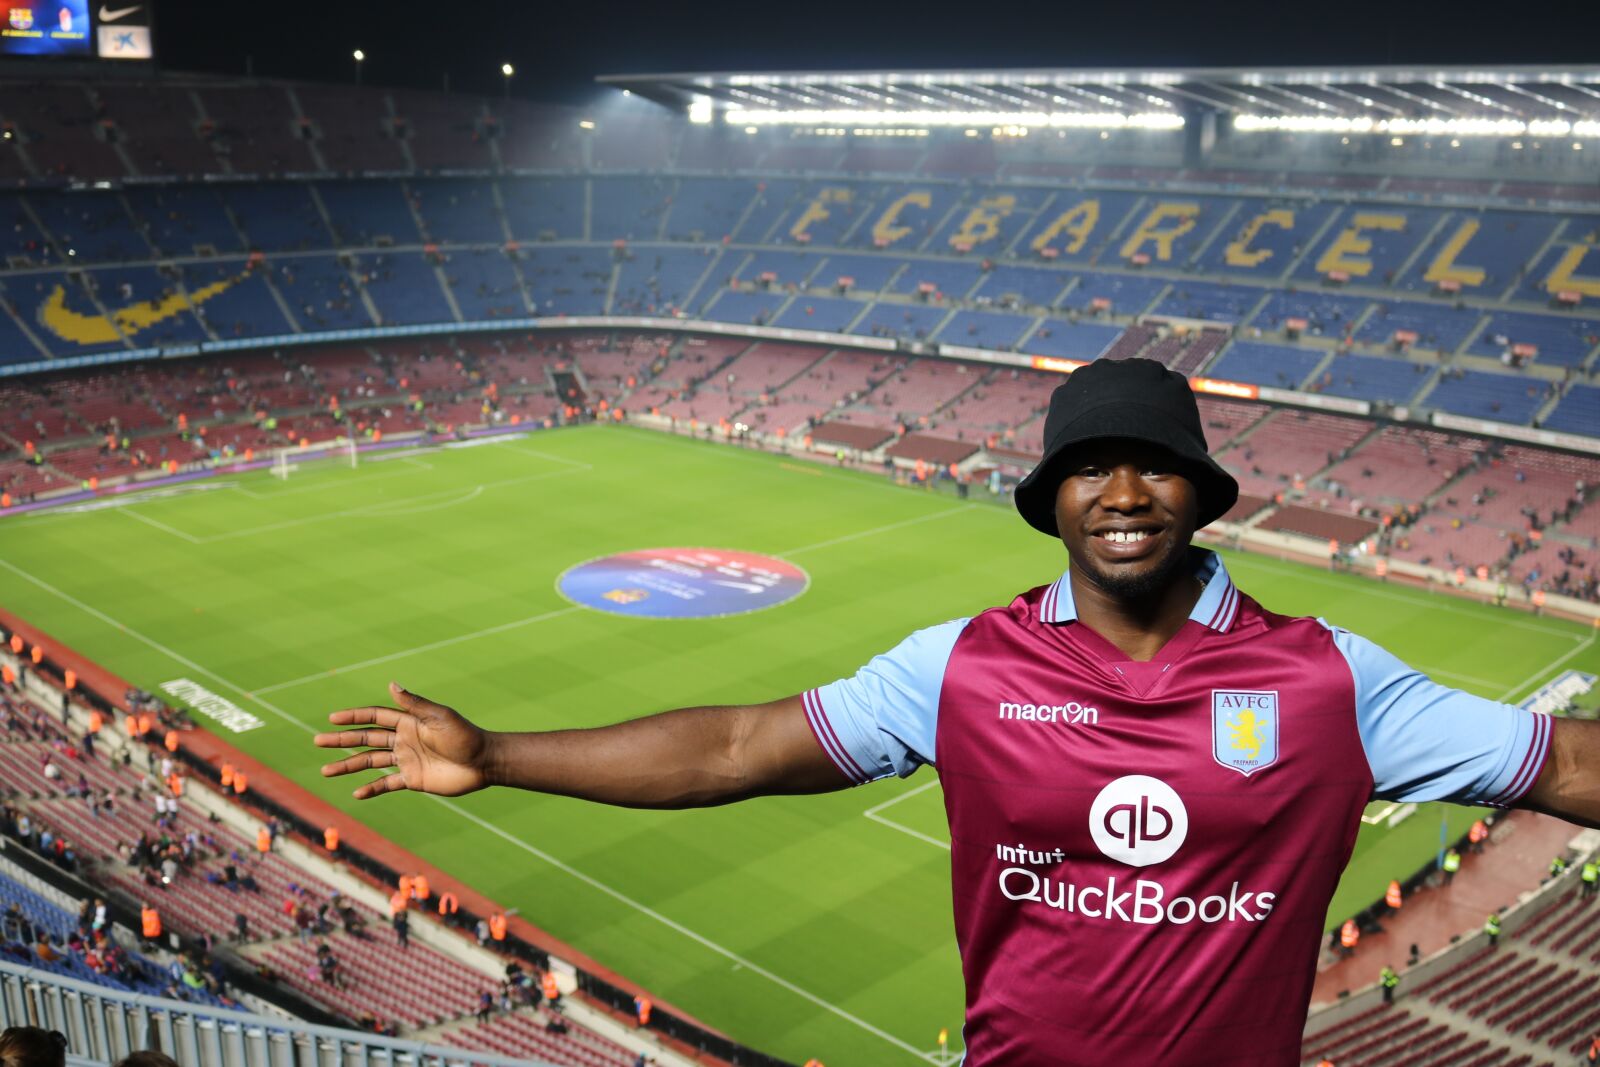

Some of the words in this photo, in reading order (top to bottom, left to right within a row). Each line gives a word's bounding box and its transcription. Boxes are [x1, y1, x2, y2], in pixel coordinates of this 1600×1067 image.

[790, 187, 932, 242] FC
[999, 701, 1098, 724] macron
[1221, 695, 1269, 709] AVFC
[998, 867, 1276, 925] QuickBooks
